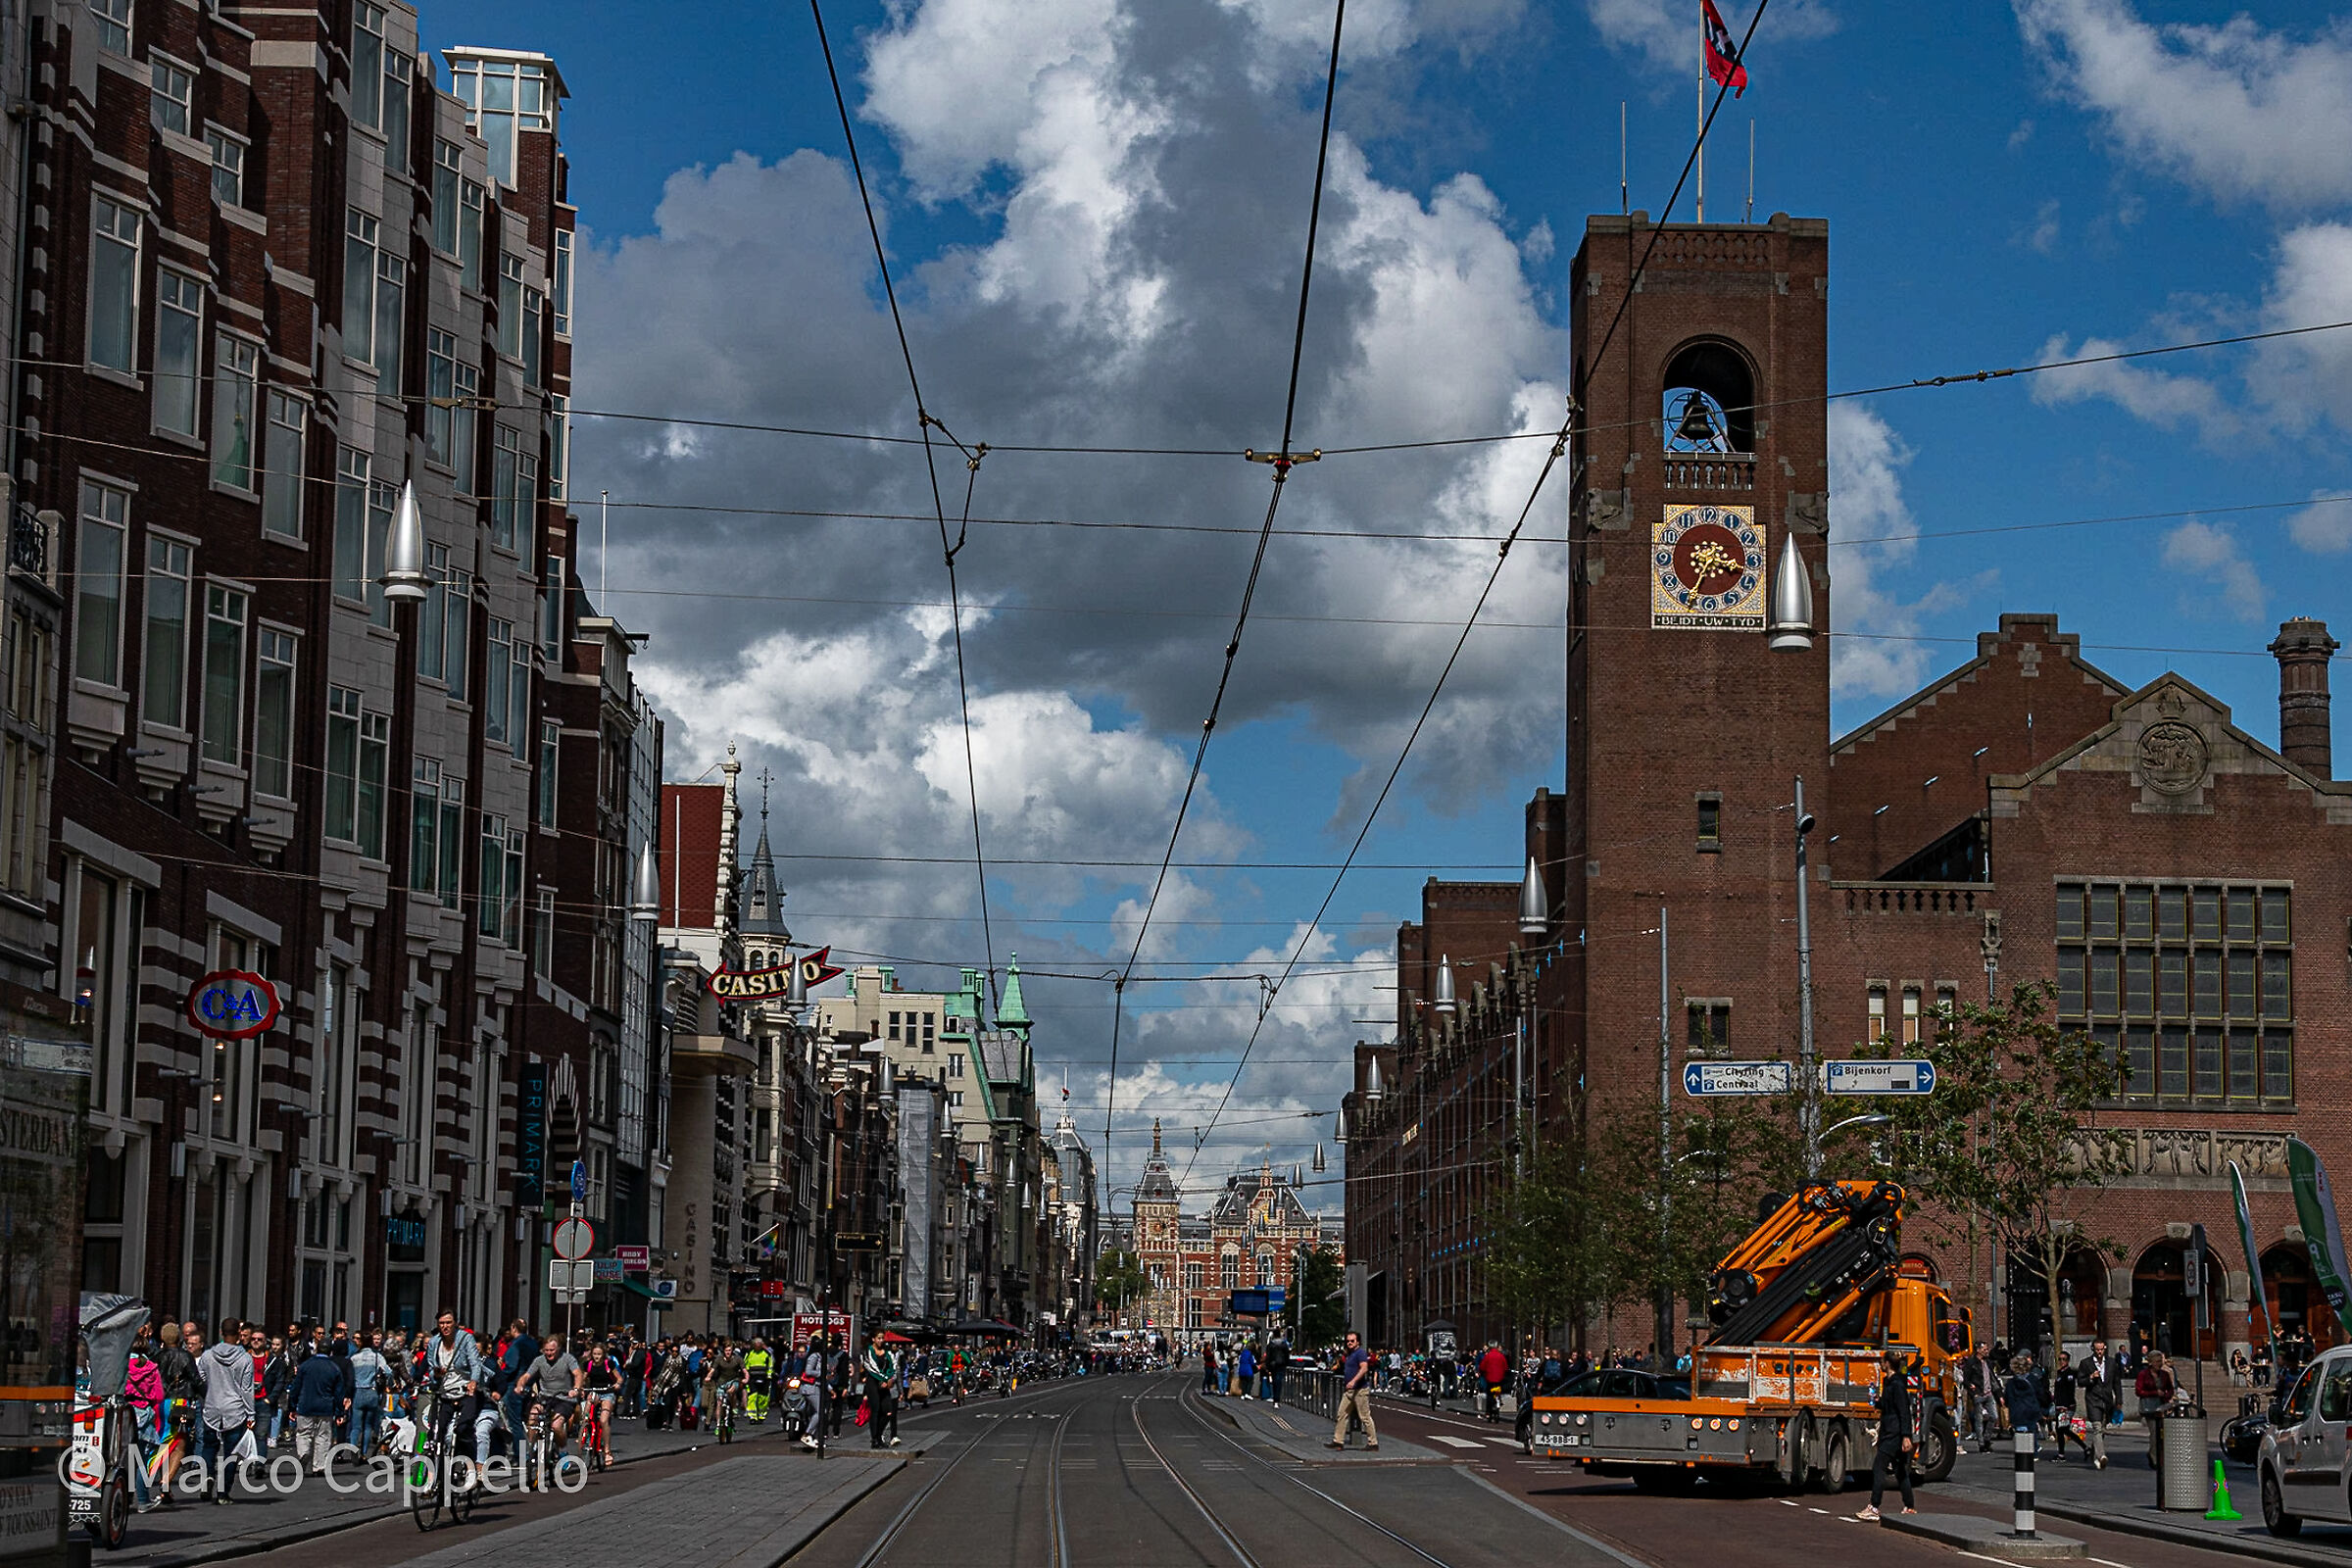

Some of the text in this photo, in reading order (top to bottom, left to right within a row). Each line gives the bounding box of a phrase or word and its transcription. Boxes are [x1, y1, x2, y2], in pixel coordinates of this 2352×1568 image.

[1681, 514, 1691, 528] 11
[1703, 509, 1715, 522] 12
[1664, 531, 1677, 545] 10
[1743, 531, 1753, 546] 2
[1659, 552, 1669, 565] 9
[1750, 554, 1759, 568] 3
[1666, 575, 1675, 590] 8
[1743, 575, 1753, 590] 4
[1704, 597, 1714, 611] 6
[1729, 593, 1737, 606] 5
[1704, 615, 1724, 625] UW
[1732, 615, 1755, 626] TYD
[202, 988, 264, 1021] C&A
[1725, 1067, 1764, 1078] Cityring
[1844, 1066, 1892, 1076] Bijenkorf
[525, 1079, 543, 1190] PRIMARK
[684, 1202, 697, 1294] CASINO
